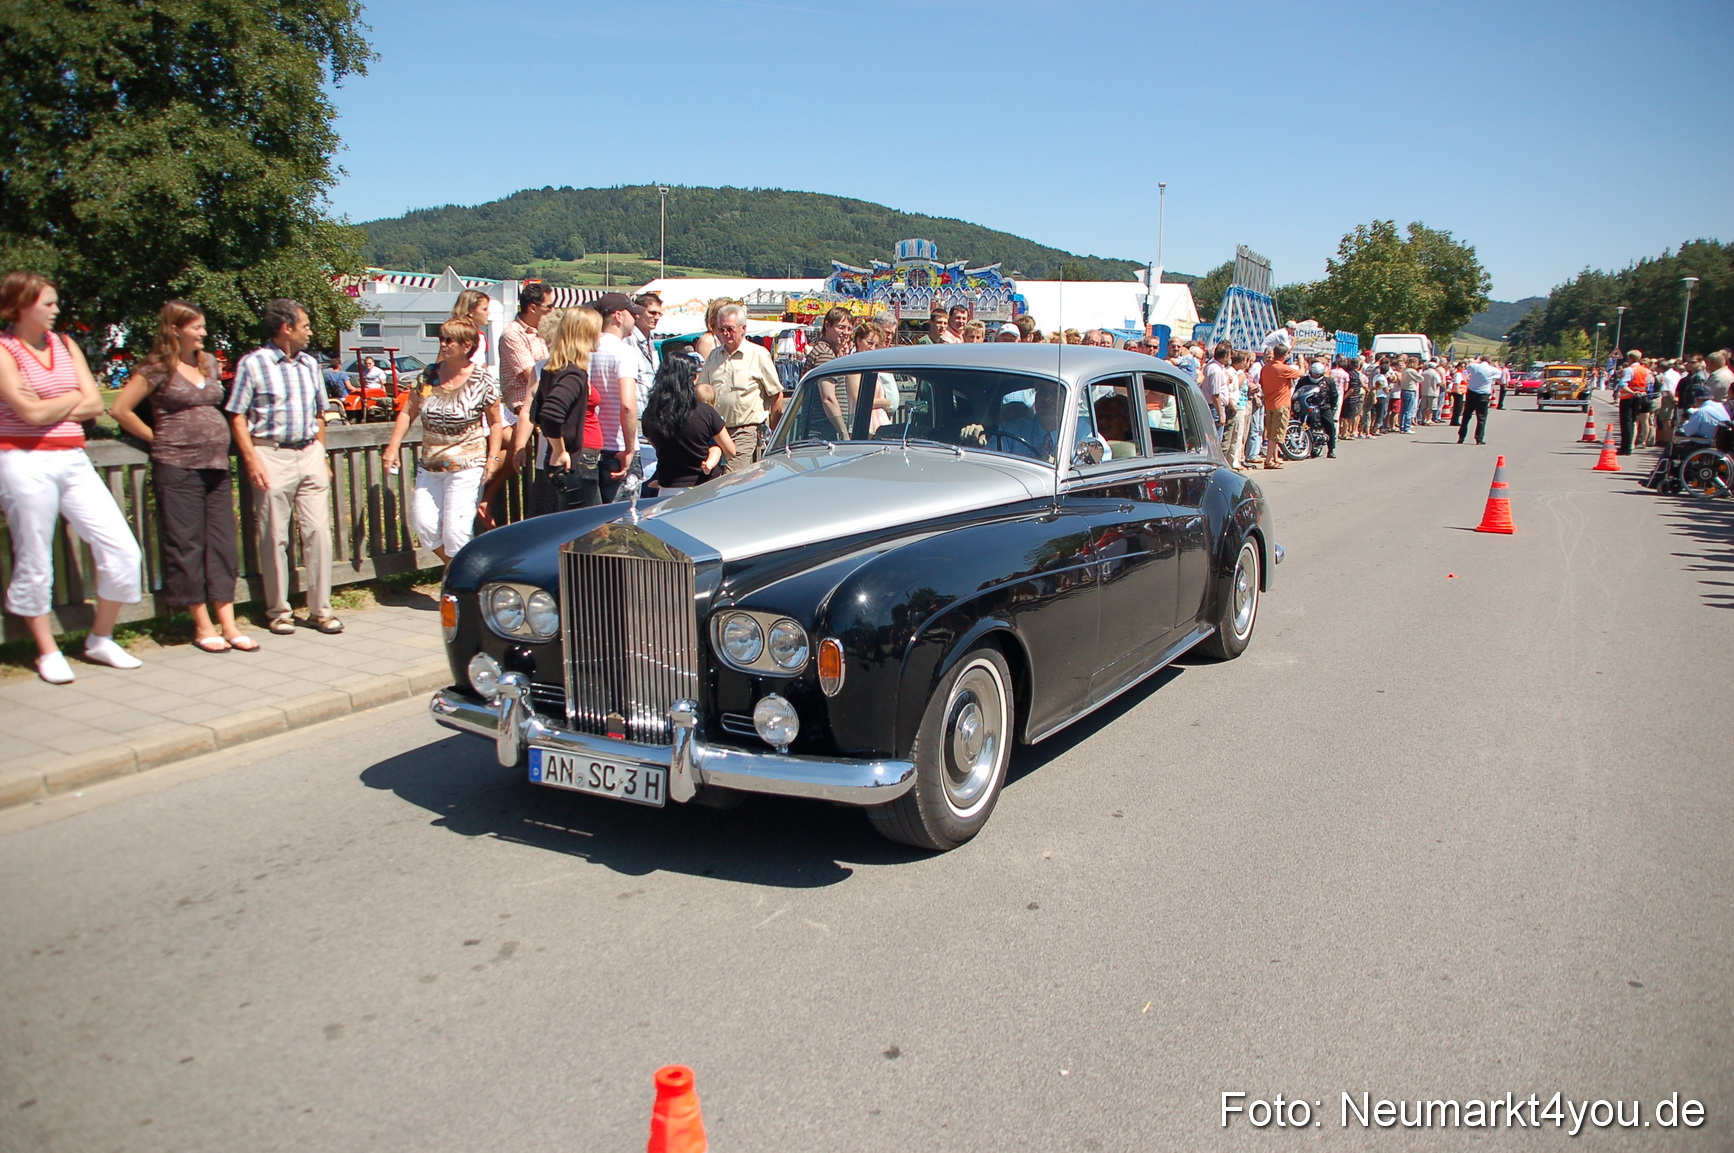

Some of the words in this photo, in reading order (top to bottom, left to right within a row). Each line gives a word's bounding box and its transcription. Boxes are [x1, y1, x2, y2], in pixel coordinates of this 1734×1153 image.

[893, 238, 938, 260] JUMPER
[546, 755, 573, 784] AN
[588, 762, 616, 791] SC
[624, 768, 637, 795] 3
[645, 771, 660, 800] H
